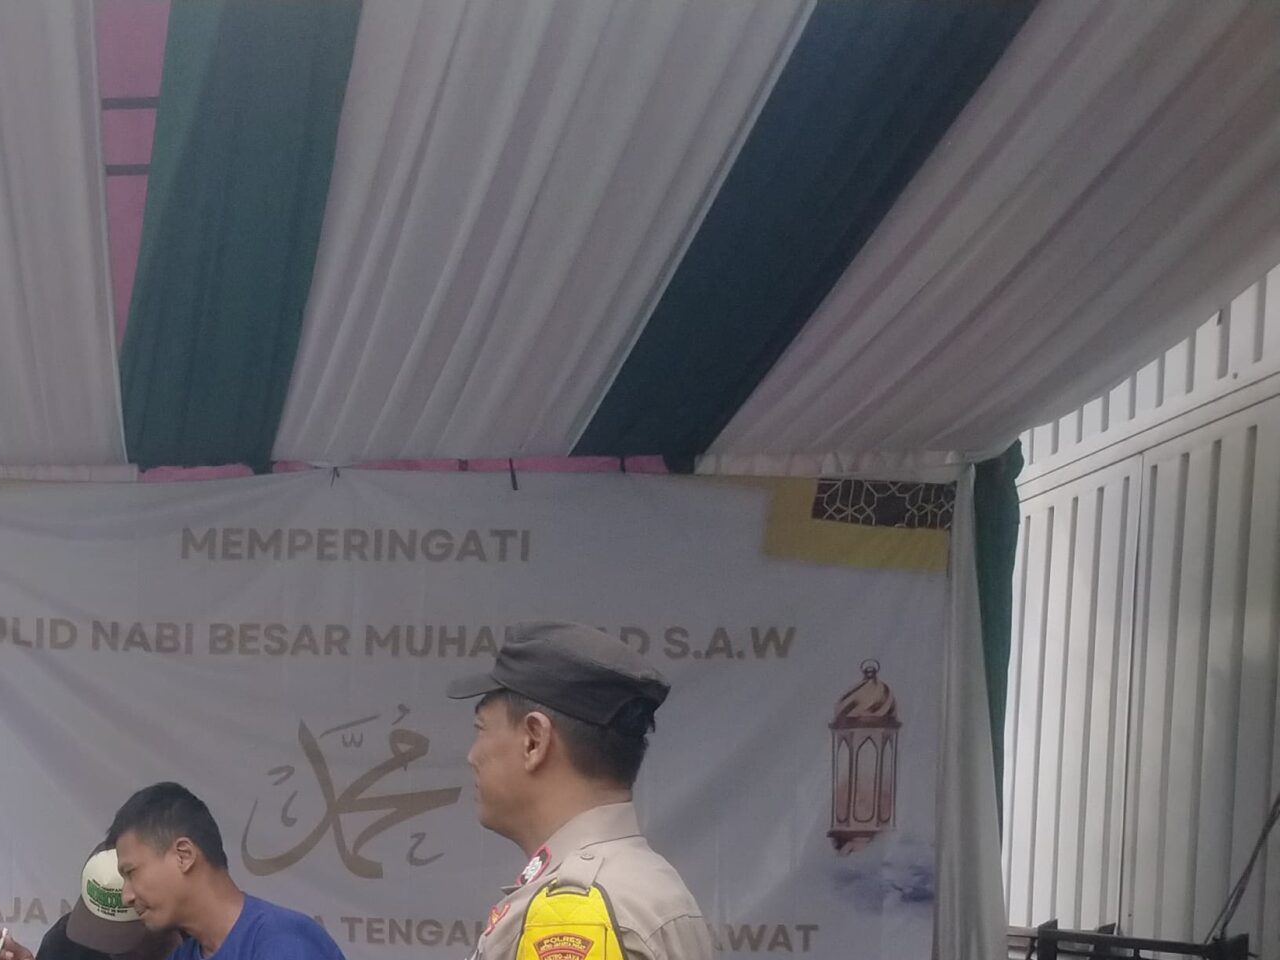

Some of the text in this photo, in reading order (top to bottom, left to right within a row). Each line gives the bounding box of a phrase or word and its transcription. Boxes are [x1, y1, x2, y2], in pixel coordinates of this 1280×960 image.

[181, 527, 531, 563] MEMPERINGATI
[91, 619, 194, 655] NABI
[208, 623, 351, 657] BESAR
[365, 624, 651, 659] MUHAD
[663, 626, 797, 660] S.A.W
